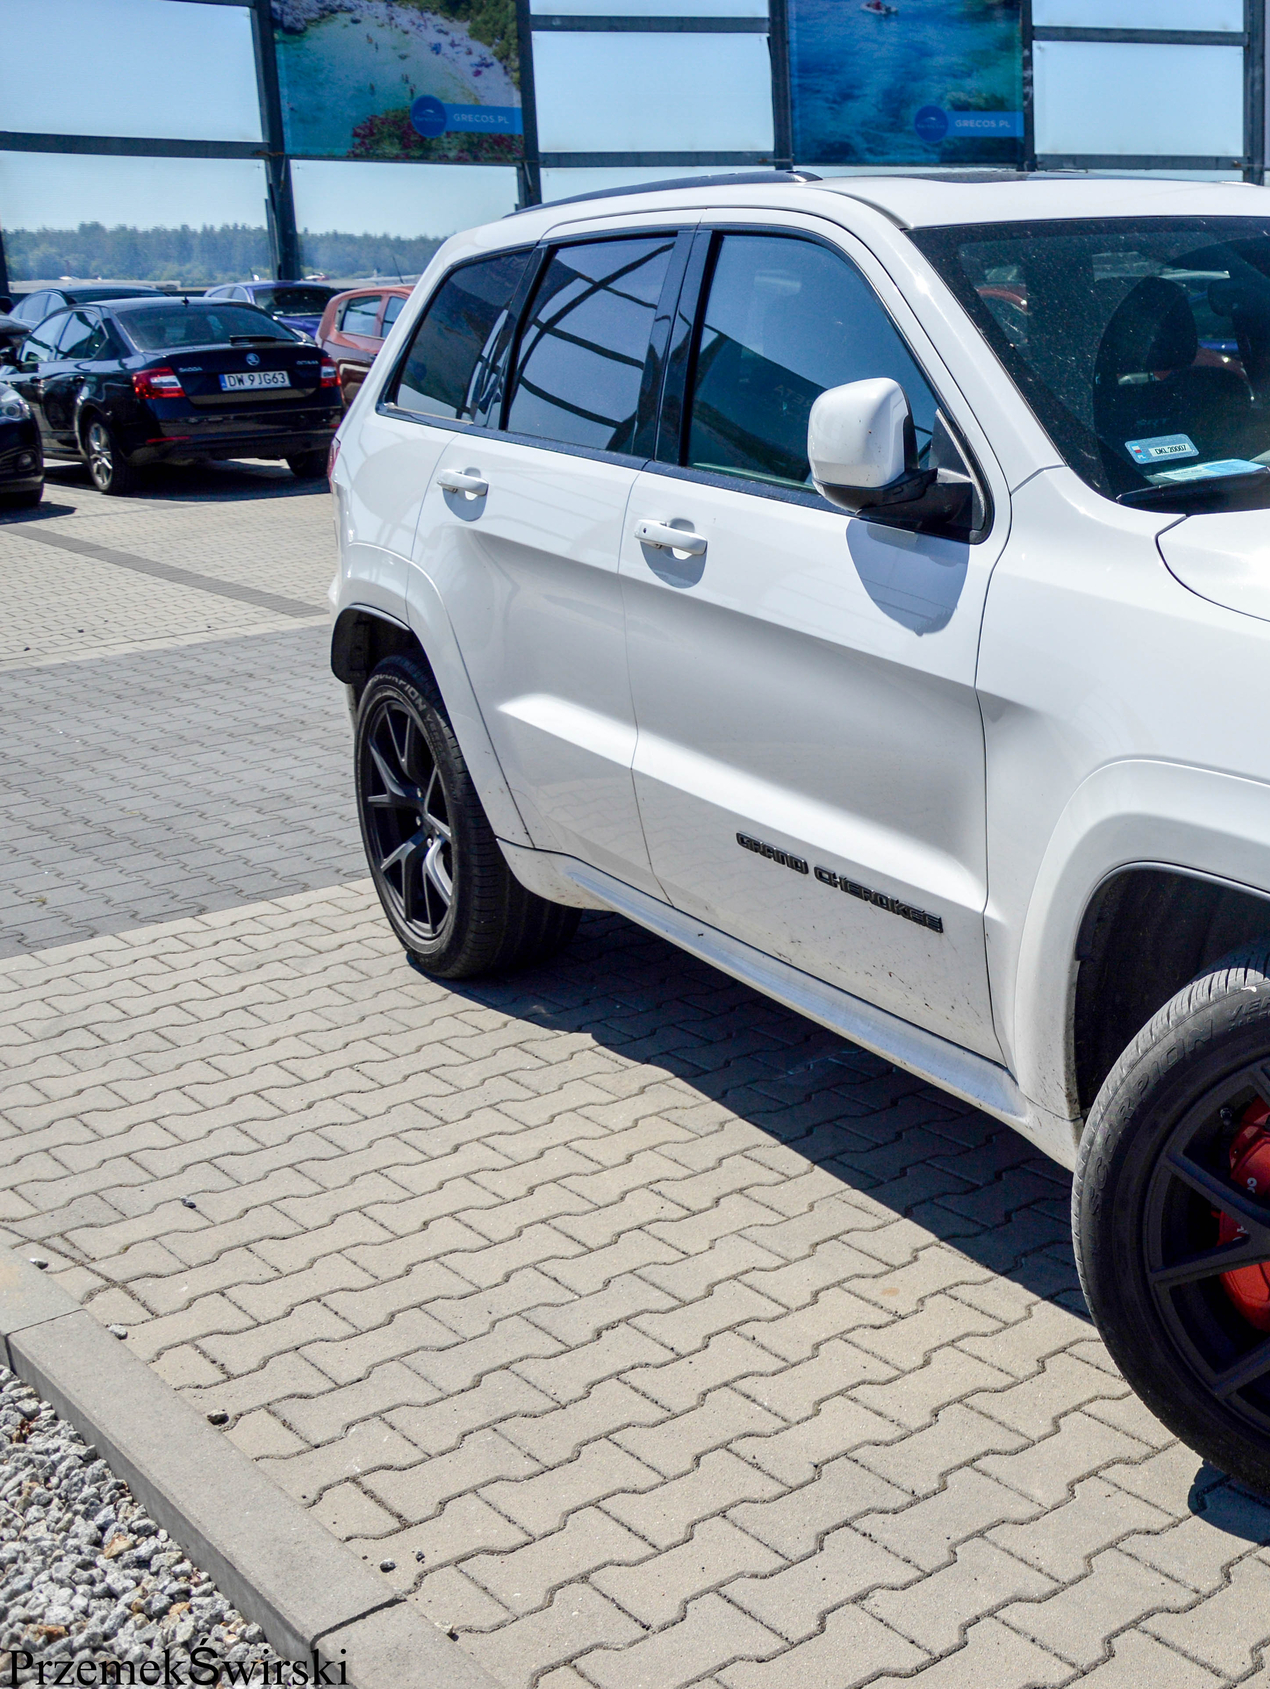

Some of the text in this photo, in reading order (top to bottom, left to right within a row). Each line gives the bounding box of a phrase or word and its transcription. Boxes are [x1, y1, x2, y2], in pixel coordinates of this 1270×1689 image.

[453, 113, 510, 124] GRECOS.PL
[955, 119, 1011, 128] GRECOS.PL
[228, 374, 245, 387] DW
[736, 831, 943, 933] GRAND CHEROKEE
